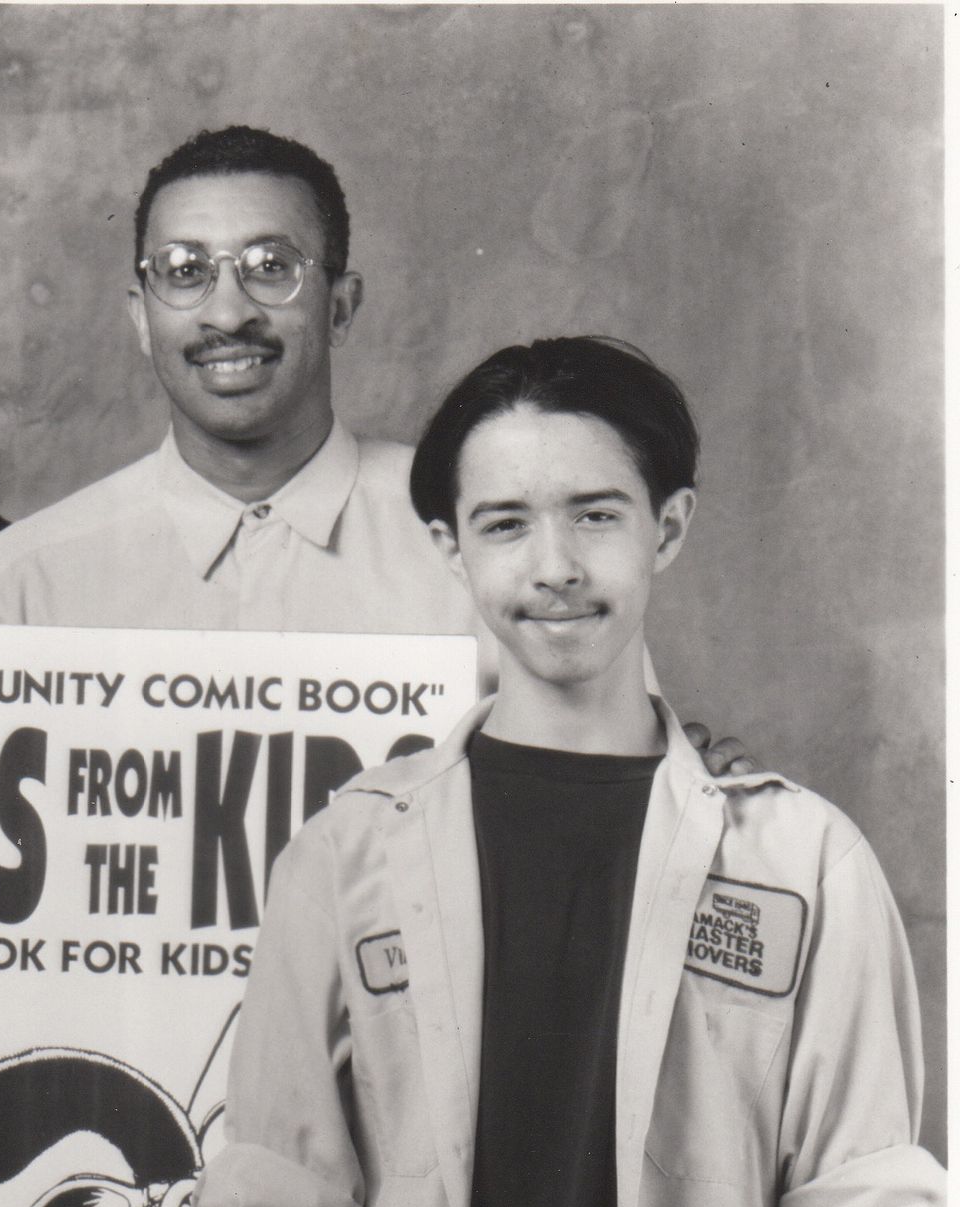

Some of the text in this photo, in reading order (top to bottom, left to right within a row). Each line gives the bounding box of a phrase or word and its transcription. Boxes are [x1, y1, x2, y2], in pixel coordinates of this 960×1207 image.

[141, 673, 283, 711] COMIC
[297, 677, 445, 716] BOOK"
[67, 747, 183, 822] FROM
[84, 843, 159, 915] THE
[61, 940, 144, 975] FOR
[161, 942, 254, 978] KIDS
[690, 923, 765, 958] ASTER
